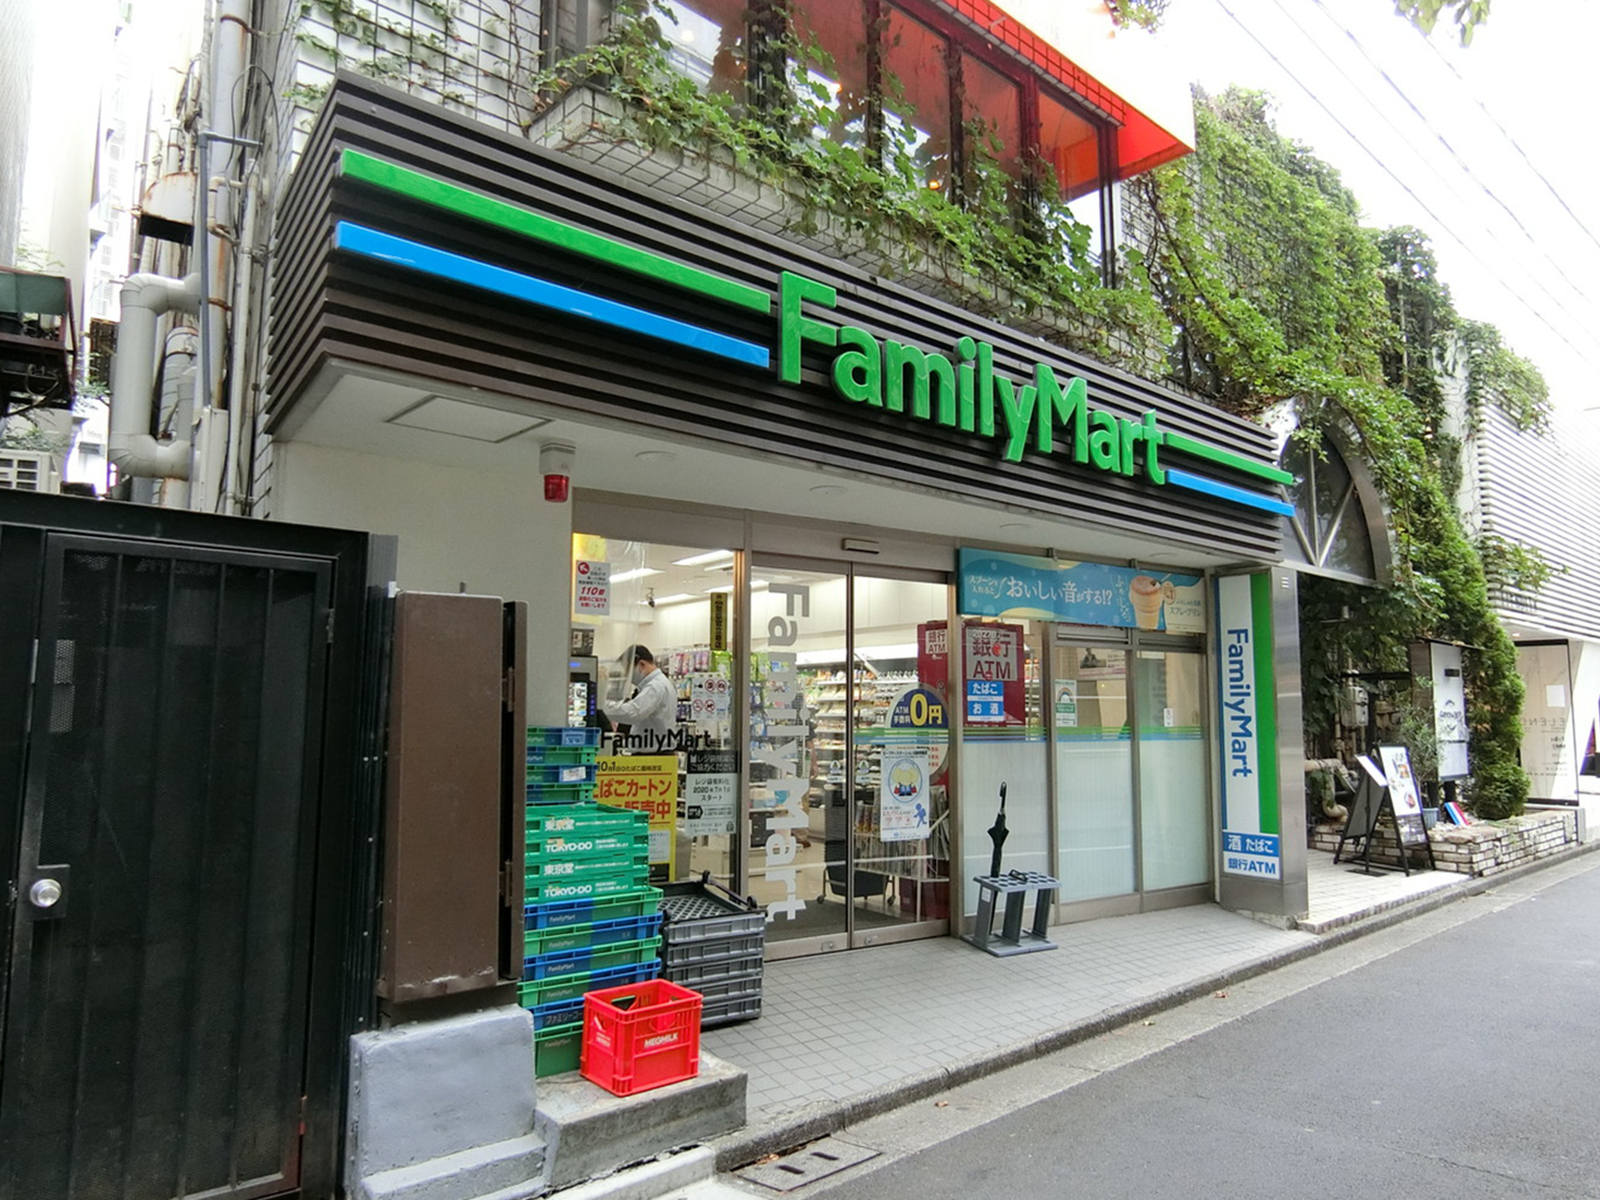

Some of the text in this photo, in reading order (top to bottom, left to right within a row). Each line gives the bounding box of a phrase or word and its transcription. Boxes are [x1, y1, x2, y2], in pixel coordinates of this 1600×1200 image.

[777, 270, 1165, 485] FamilyMart
[928, 630, 946, 643] 銀行
[928, 643, 946, 653] ATM
[972, 660, 1011, 679] ATM
[972, 683, 999, 695] たばこ
[895, 706, 909, 715] ATM
[910, 693, 942, 726] 0円
[1224, 628, 1253, 777] FamilyMart
[600, 728, 711, 752] FamilyMart
[755, 583, 810, 922] FamilyMart
[593, 778, 672, 798] ばこカートン
[1228, 835, 1274, 854] 酒 たばこ
[543, 862, 574, 876] 東京堂
[1227, 857, 1277, 875] 銀行ATM
[549, 914, 576, 923] FamilyMart
[548, 940, 575, 949] FamilyMart
[547, 963, 574, 972] FamilyMart
[644, 1032, 679, 1049] MEGMILK
